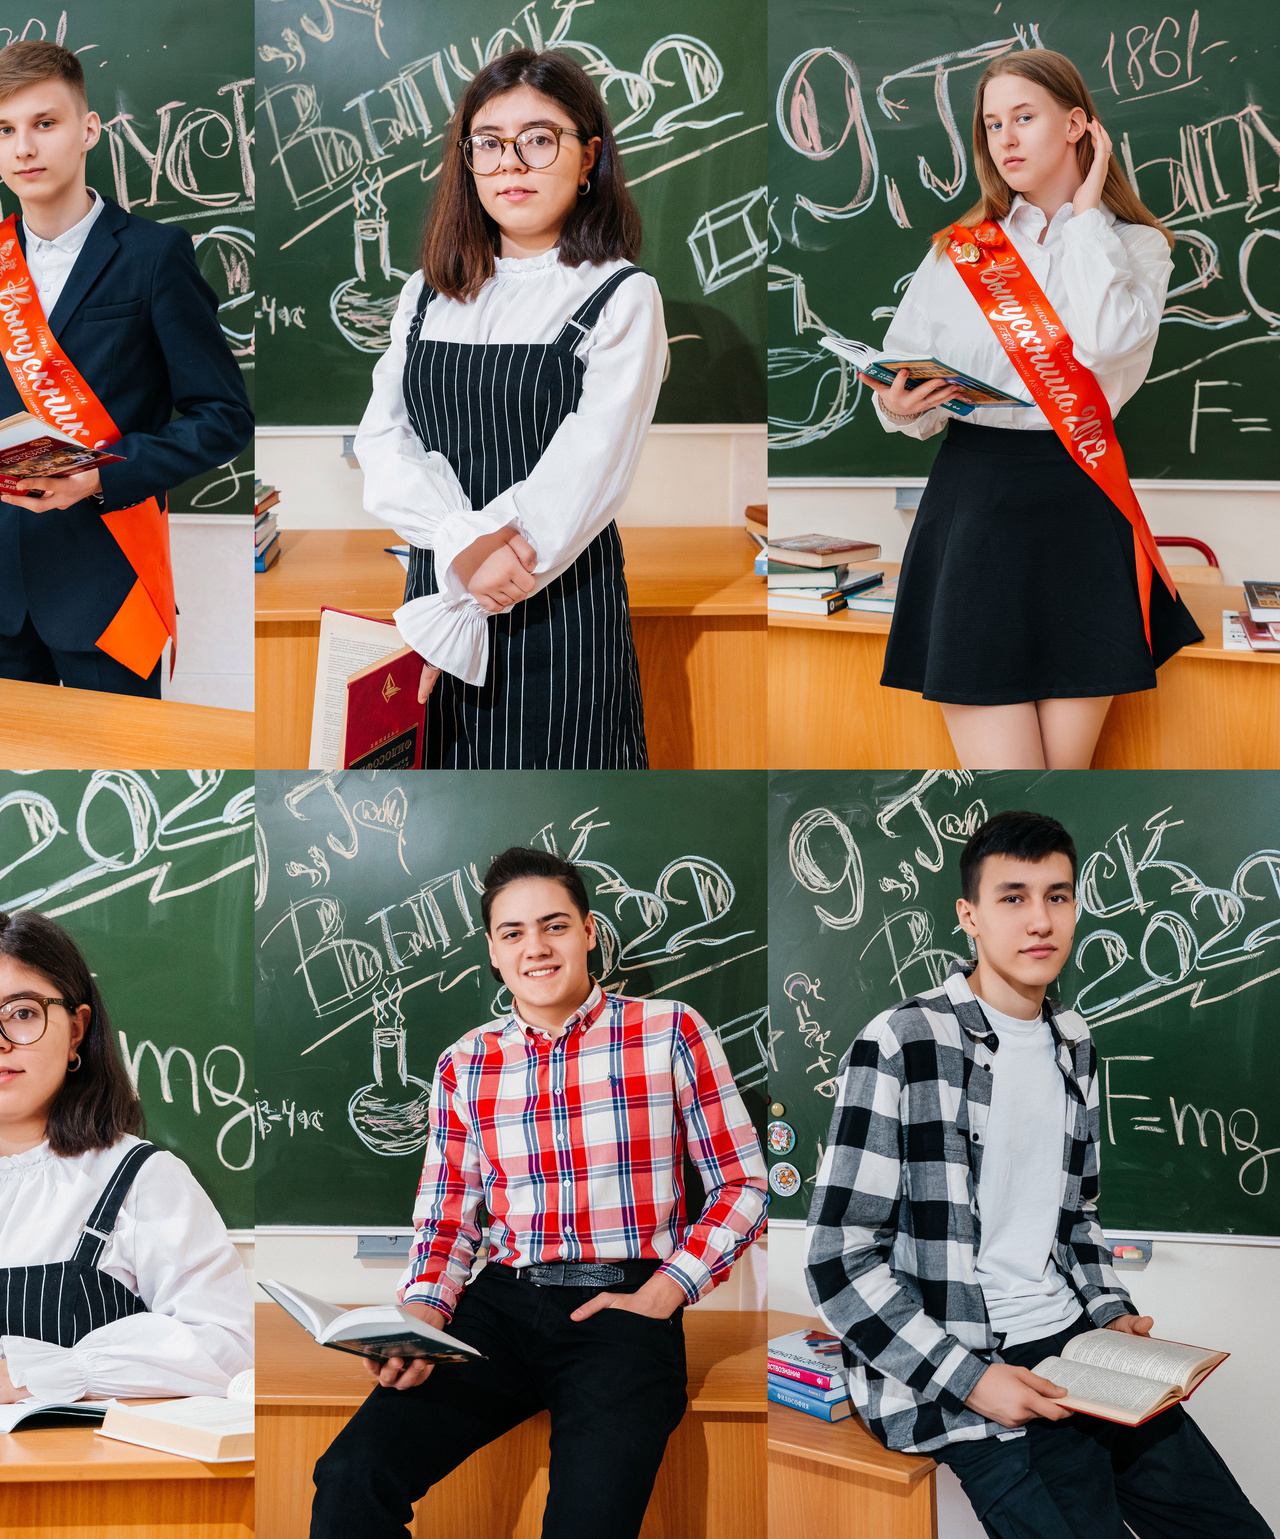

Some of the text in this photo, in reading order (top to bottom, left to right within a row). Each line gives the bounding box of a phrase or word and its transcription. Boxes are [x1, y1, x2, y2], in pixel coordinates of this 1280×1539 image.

[1025, 290, 1060, 340] Денисова
[978, 257, 1107, 470] Выпускница 2022
[361, 738, 412, 769] ФИЛОСОФ
[776, 1393, 810, 1410] ФИЛОСОФИЯ
